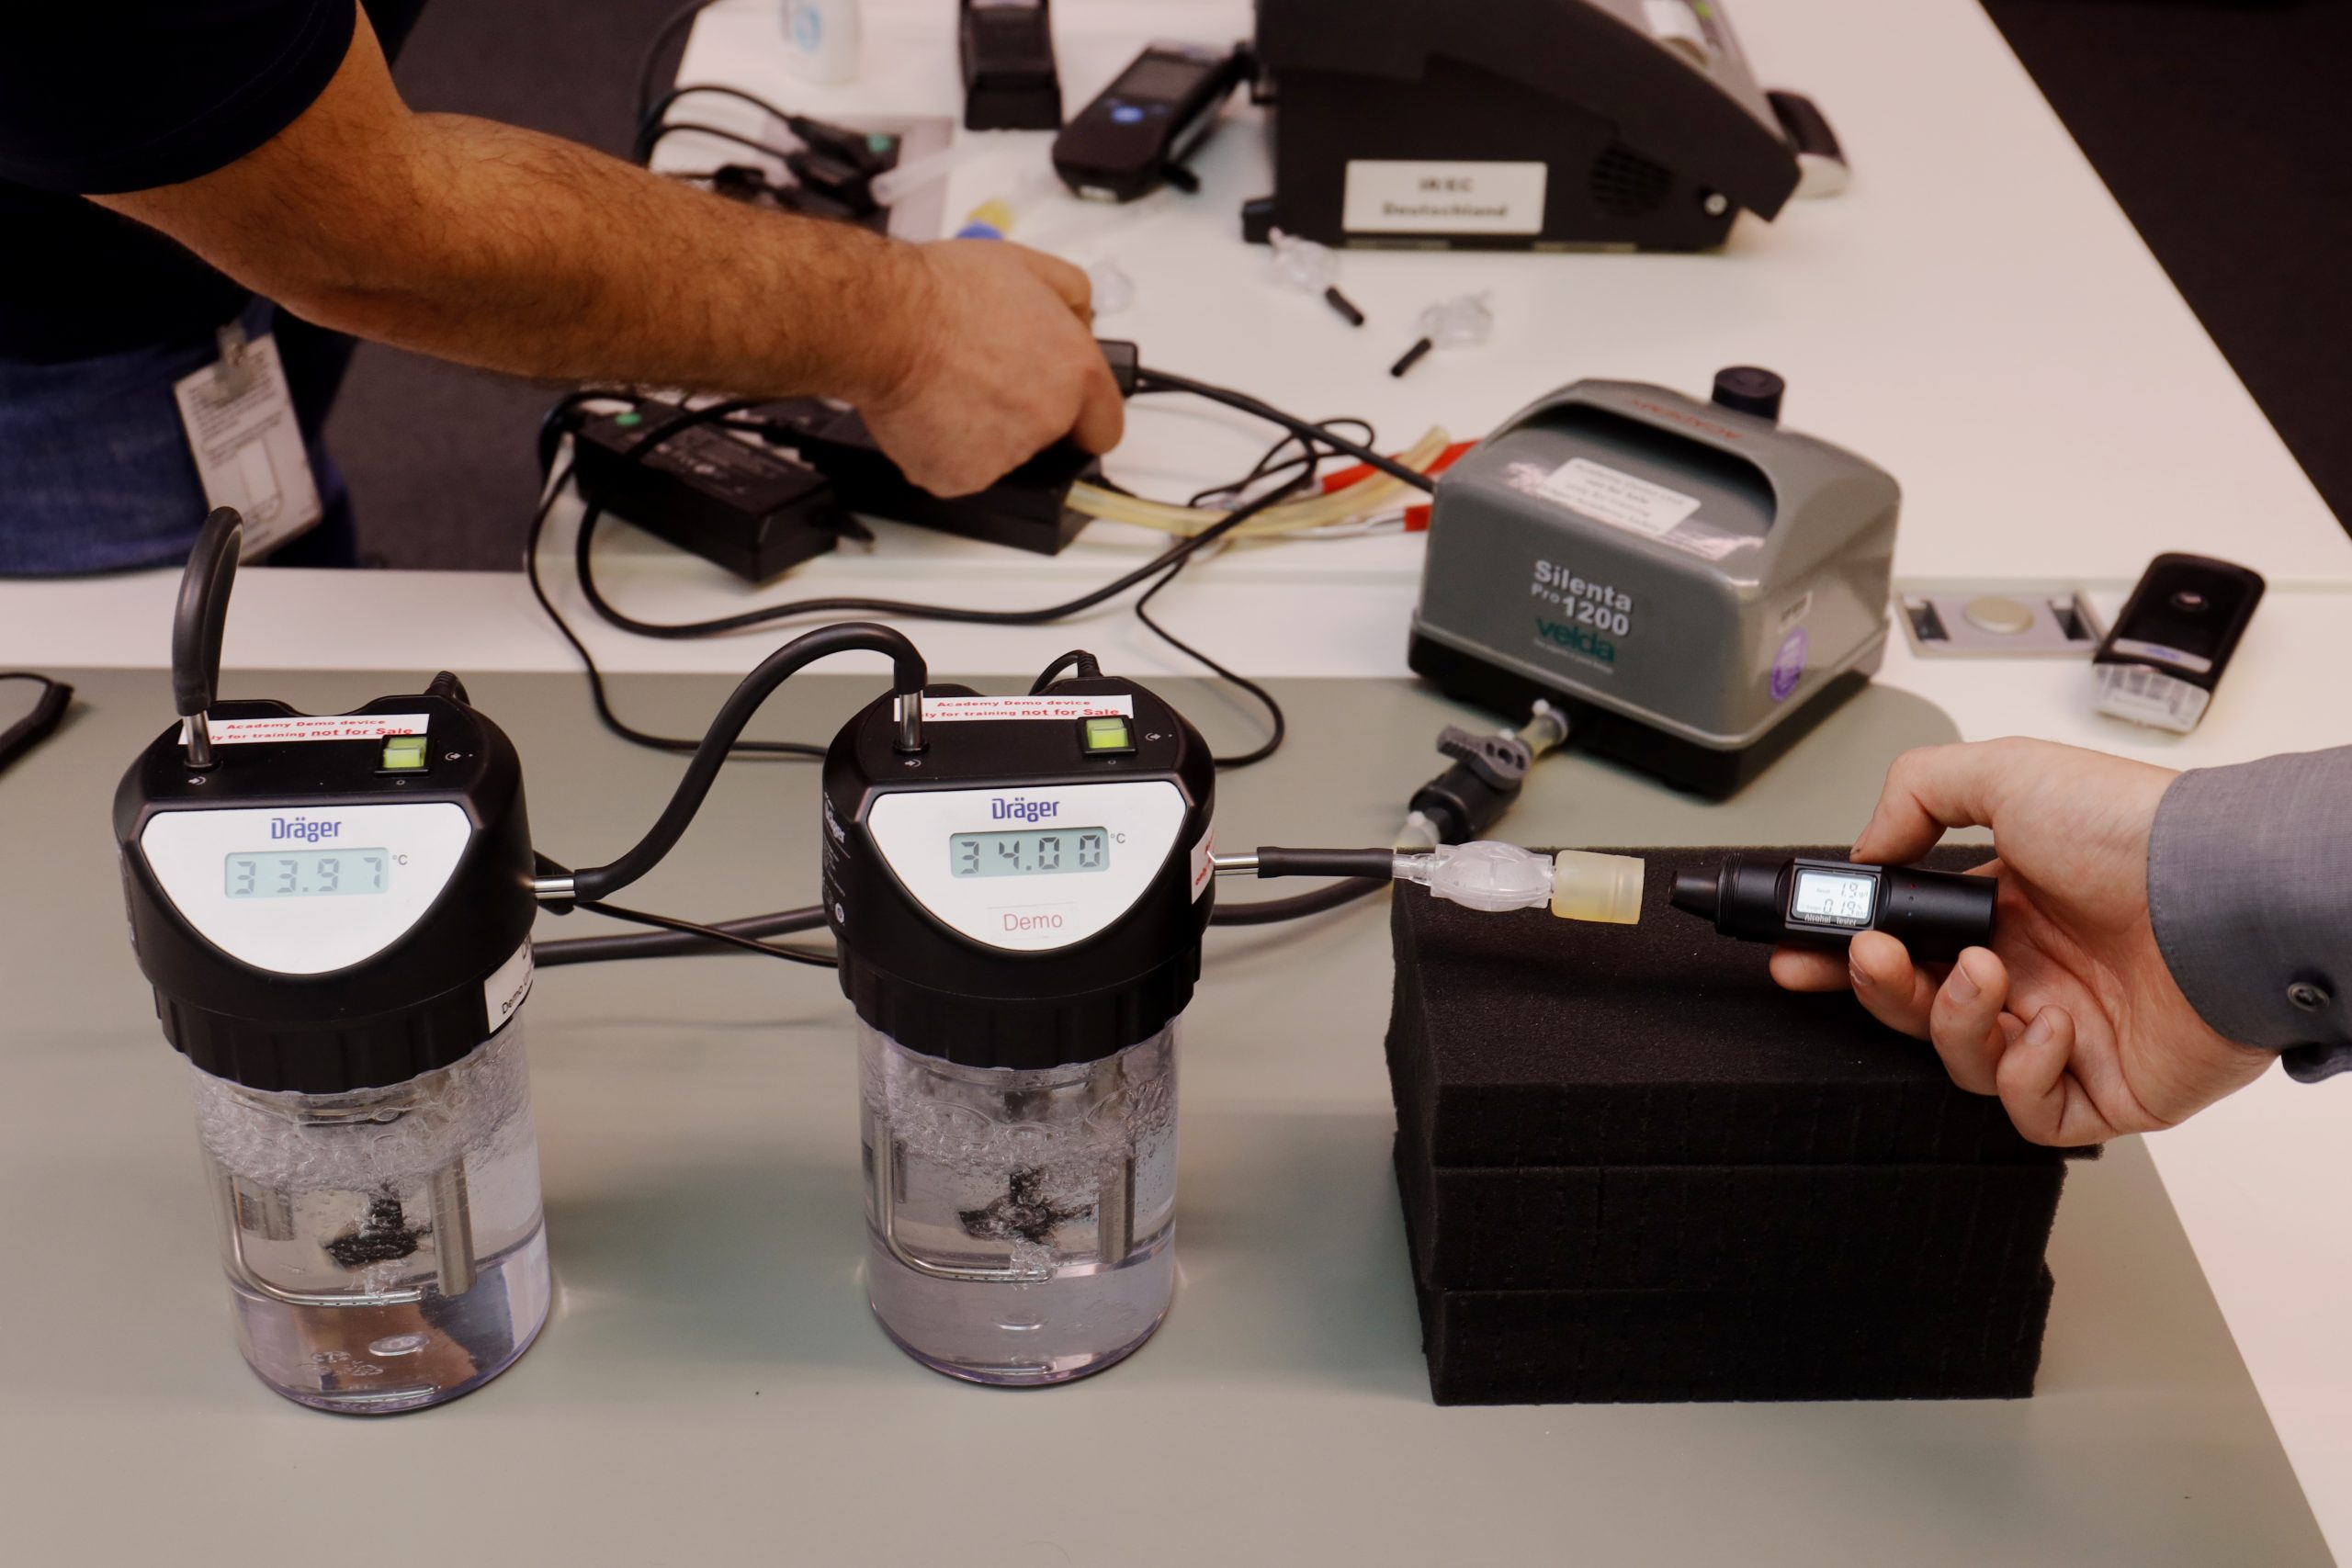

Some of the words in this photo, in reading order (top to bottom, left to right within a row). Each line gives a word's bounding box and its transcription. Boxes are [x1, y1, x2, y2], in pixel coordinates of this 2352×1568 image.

[1382, 201, 1509, 218] Deutschland
[1534, 559, 1632, 613] Silenta
[1531, 582, 1560, 604] Pro
[1563, 595, 1630, 636] 1200
[1535, 617, 1615, 661] velda
[937, 700, 1000, 708] Academy
[942, 710, 959, 718] for
[965, 709, 1017, 718] training
[1022, 708, 1049, 716] not
[1055, 707, 1078, 716] for
[1083, 707, 1120, 716] Sale
[227, 722, 291, 730] Academy
[296, 719, 335, 728] Demo
[253, 731, 306, 740] training
[311, 728, 339, 737] not
[345, 727, 369, 736] for
[376, 727, 413, 736] Sale
[991, 796, 1060, 823] Dräger
[271, 817, 342, 842] Dräger
[961, 834, 1101, 874] 34.00
[1110, 832, 1125, 844] °C
[234, 856, 382, 895] 33.97
[392, 854, 408, 865] °C
[1003, 913, 1063, 931] Demo
[1804, 913, 1831, 925] Alcohol
[1836, 917, 1857, 927] Tester
[502, 986, 524, 1014] Demo
